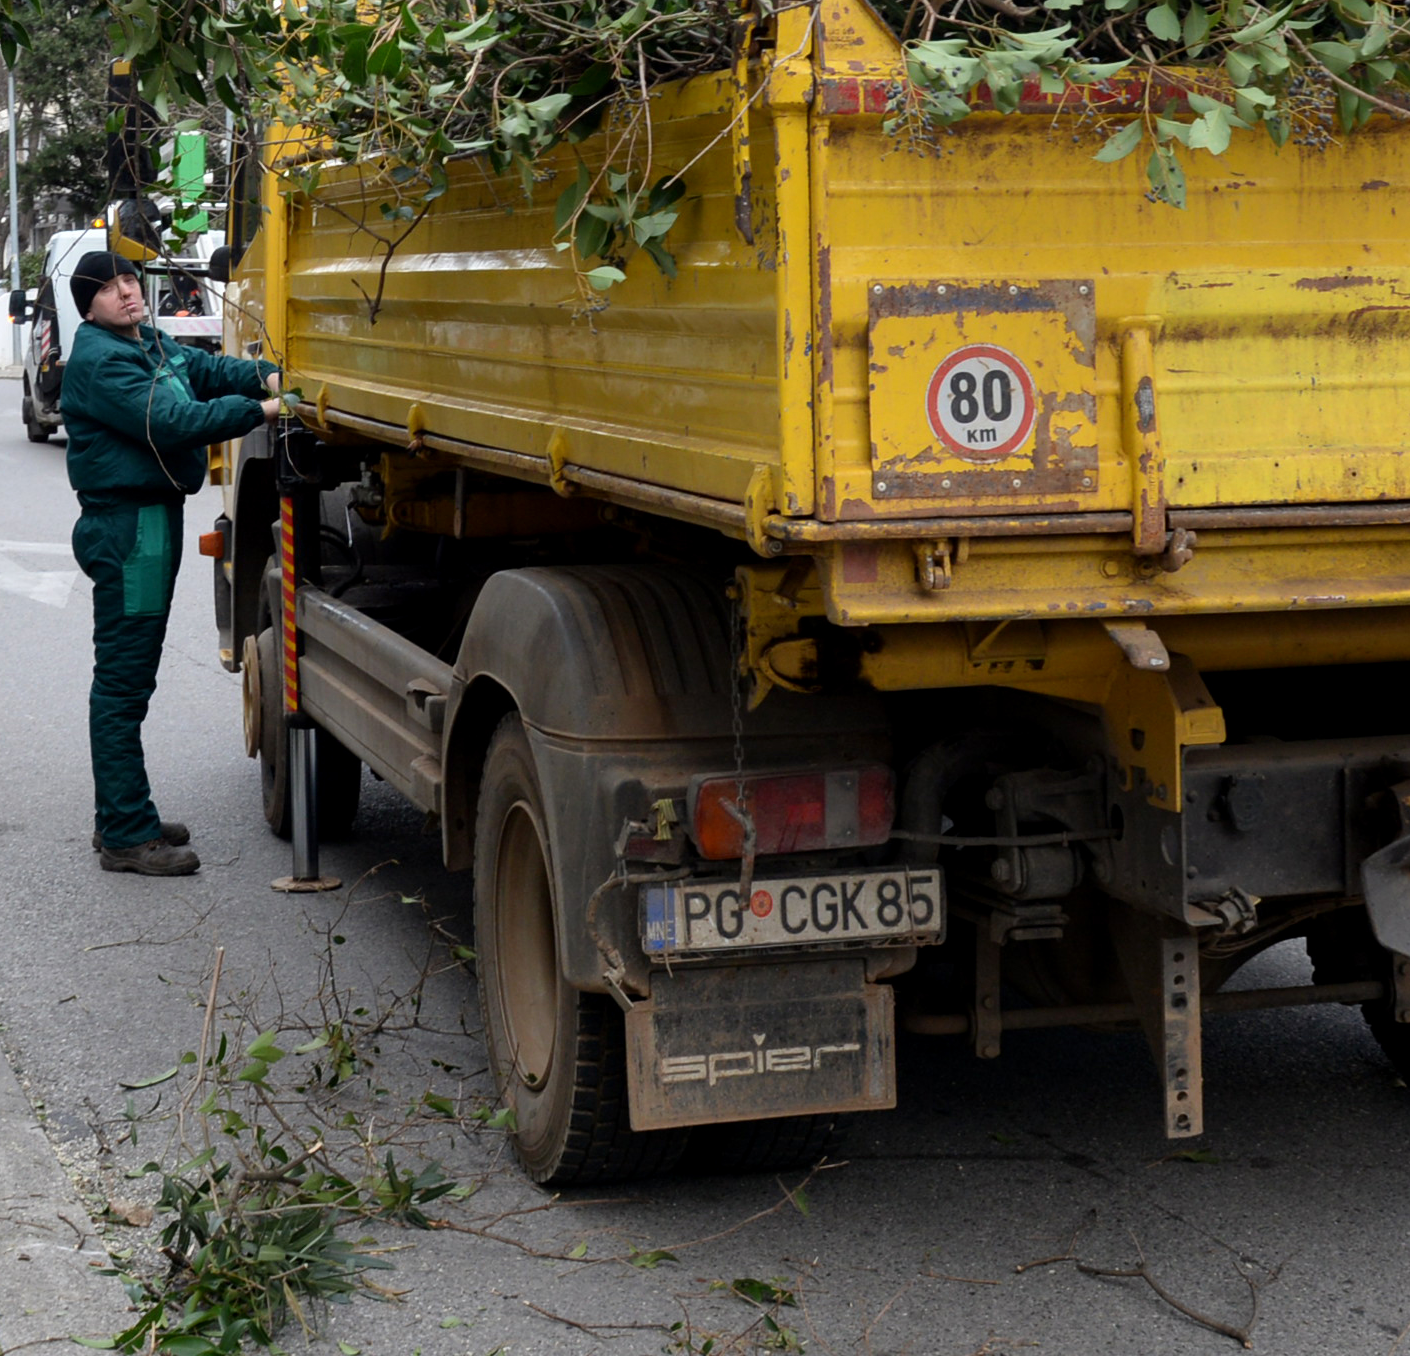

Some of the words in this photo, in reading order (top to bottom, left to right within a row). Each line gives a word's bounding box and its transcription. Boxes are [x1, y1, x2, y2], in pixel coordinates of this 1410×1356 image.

[950, 370, 1012, 424] 80
[685, 890, 745, 939] PG
[661, 1033, 861, 1087] spier
